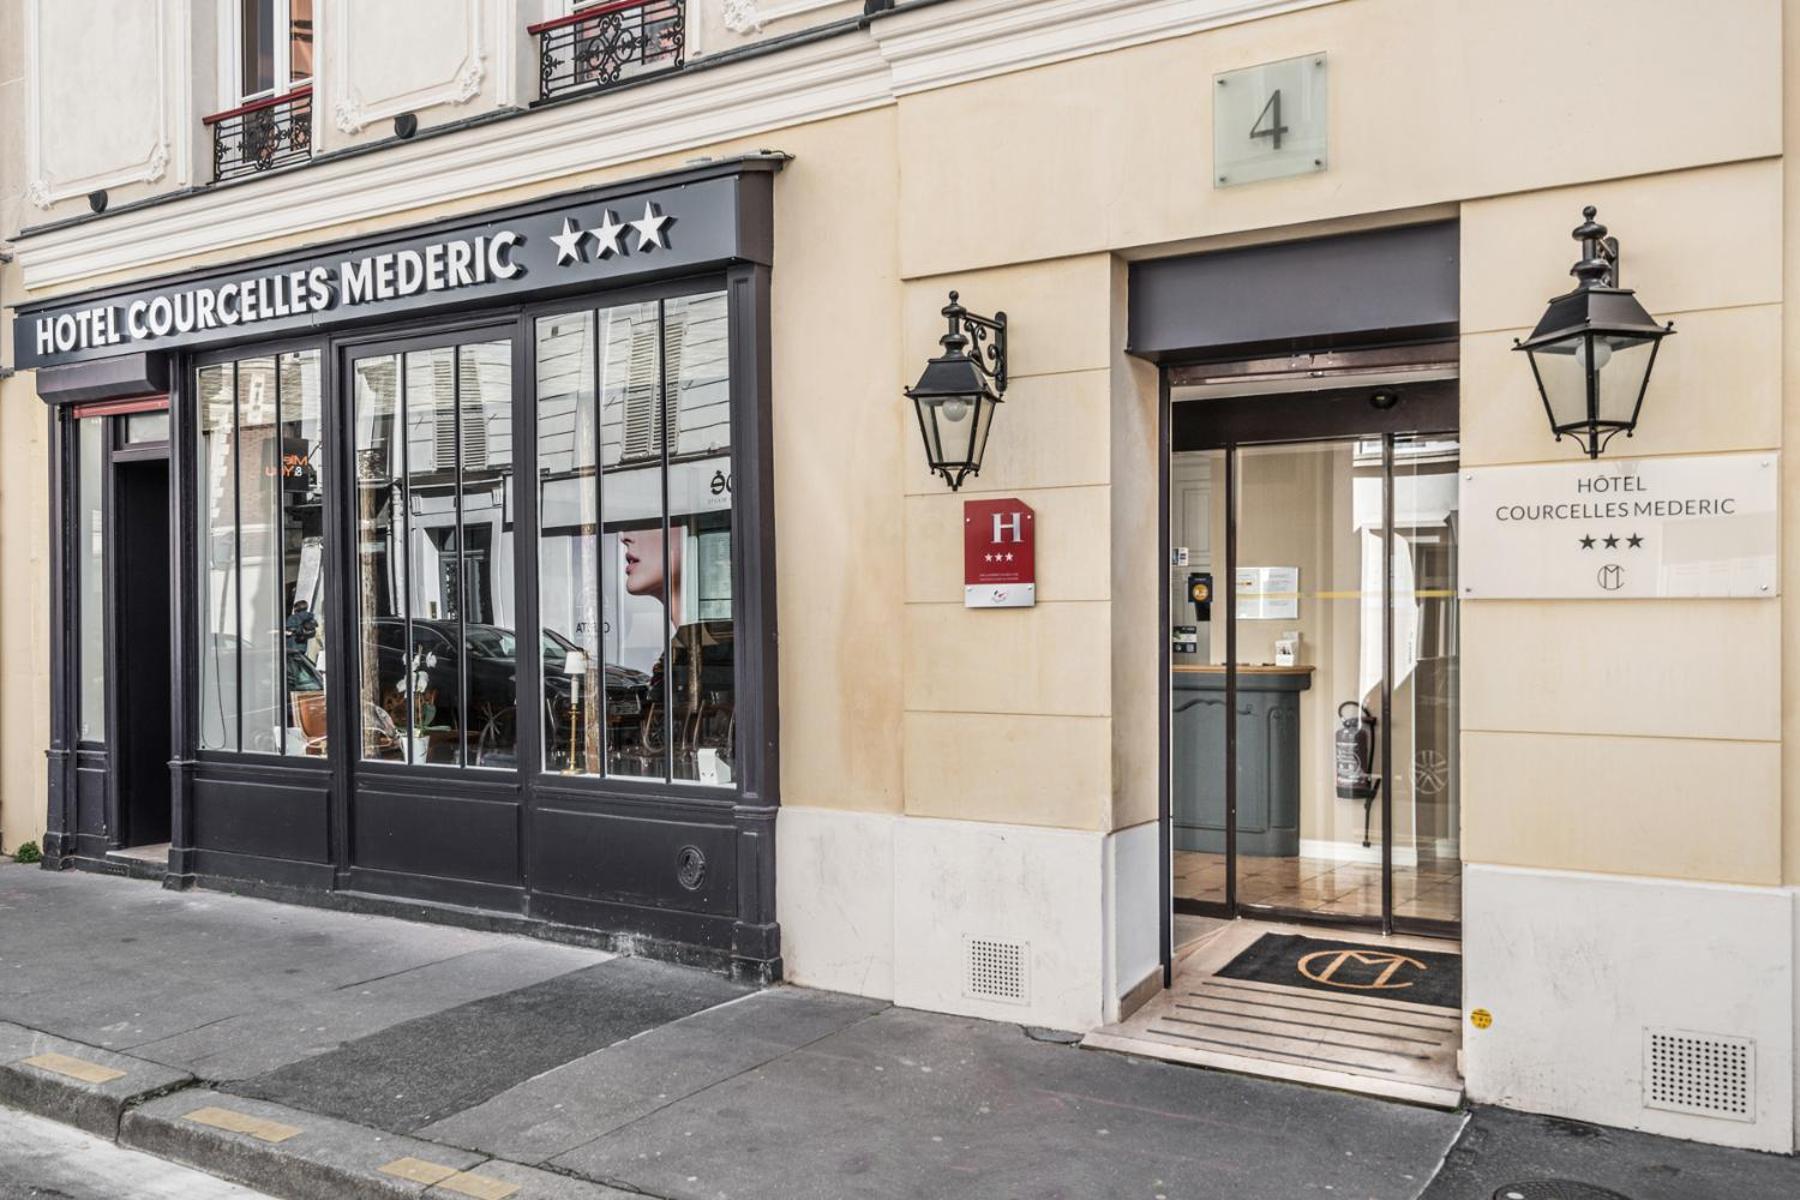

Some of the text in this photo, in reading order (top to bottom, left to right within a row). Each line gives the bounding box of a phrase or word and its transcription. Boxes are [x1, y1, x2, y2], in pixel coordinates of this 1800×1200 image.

[1249, 88, 1288, 150] 4
[36, 230, 519, 355] HOTEL COURCELLES MEDERIC
[1577, 474, 1648, 494] HÔTEL
[1496, 498, 1736, 522] COURCELLES MEDERIC
[990, 511, 1025, 544] H
